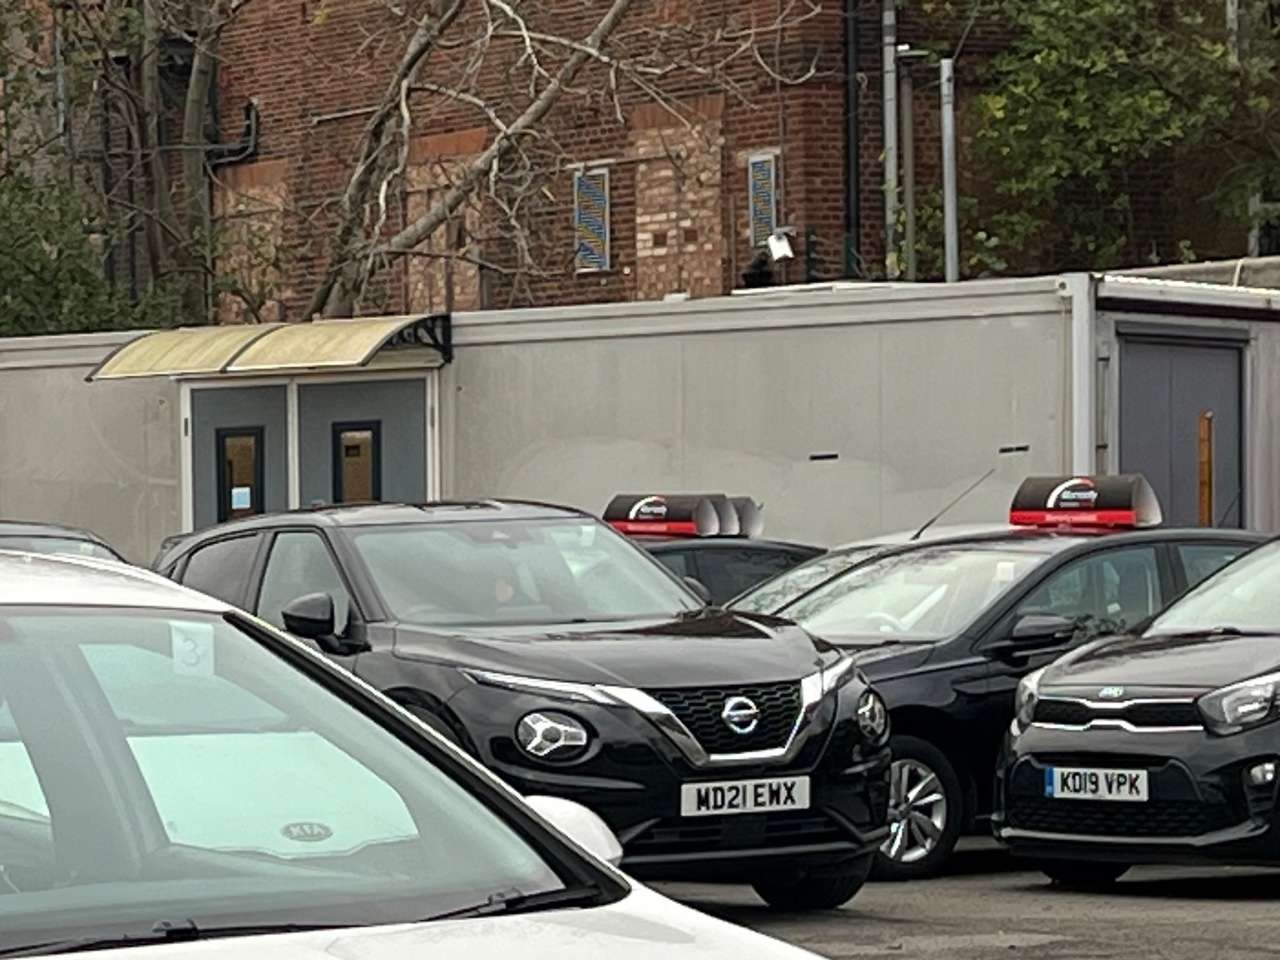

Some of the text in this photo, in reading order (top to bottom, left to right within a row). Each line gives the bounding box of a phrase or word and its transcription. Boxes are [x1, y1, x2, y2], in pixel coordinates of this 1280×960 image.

[696, 781, 797, 811] MD21 EWX
[1060, 771, 1140, 796] KD19 VPK
